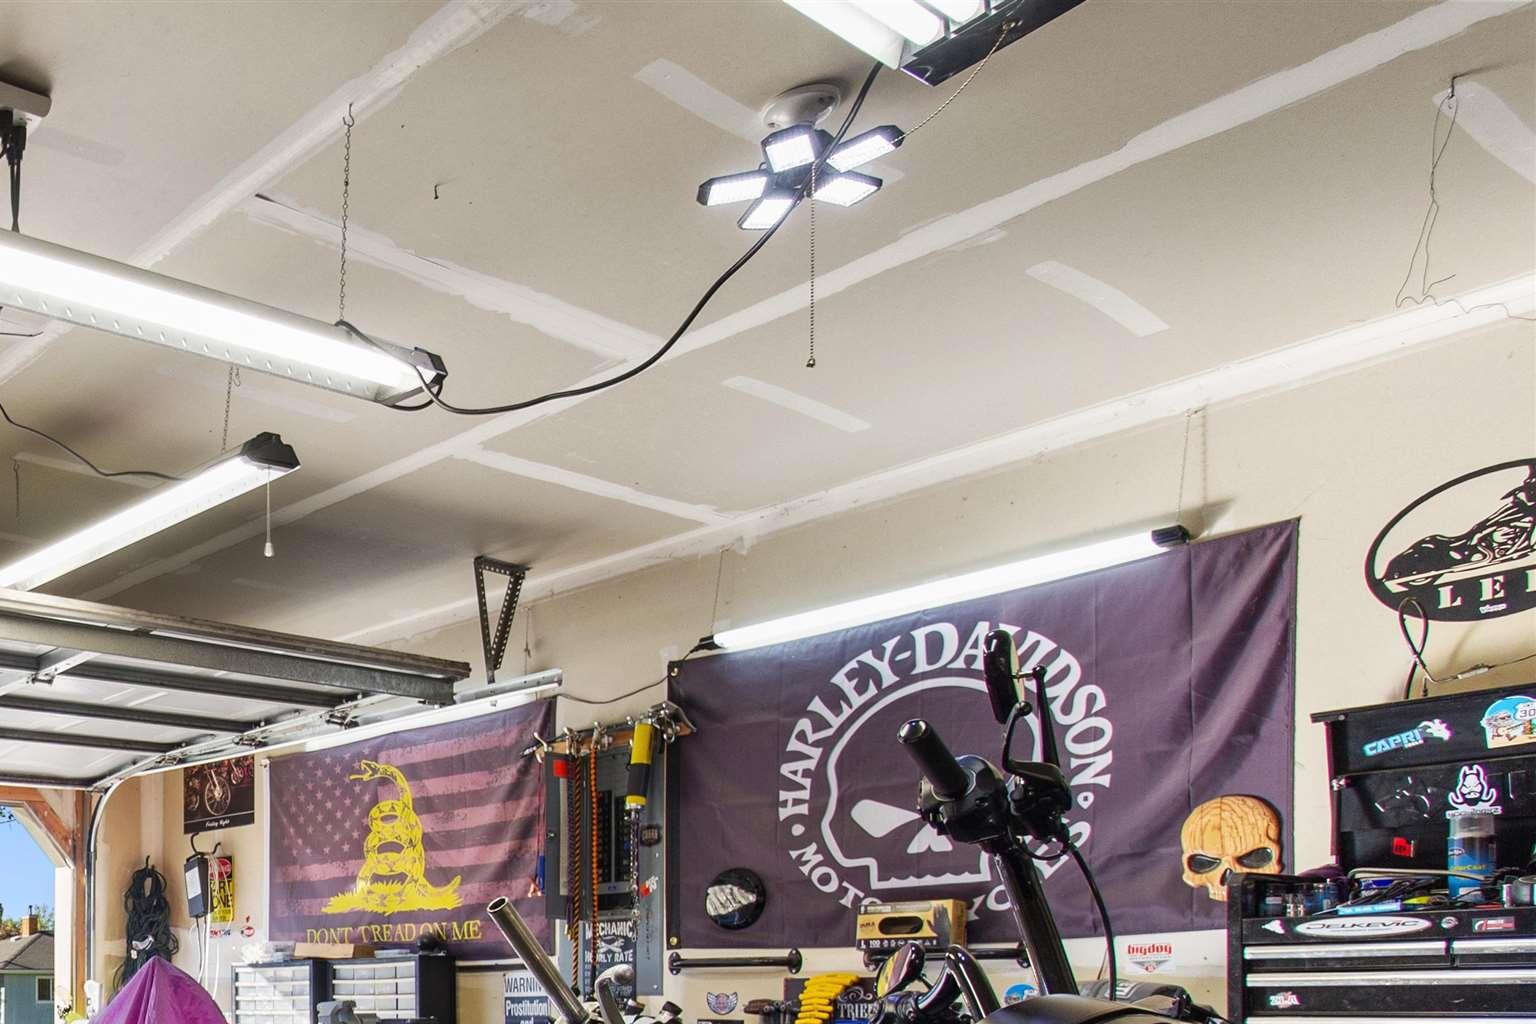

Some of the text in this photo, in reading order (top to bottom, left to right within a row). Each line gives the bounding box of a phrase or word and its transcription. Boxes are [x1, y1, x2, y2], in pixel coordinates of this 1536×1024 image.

[1363, 730, 1424, 757] CAPRI
[358, 923, 416, 943] TREAD
[451, 919, 482, 941] ME
[614, 949, 634, 963] RATE
[506, 999, 548, 1017] Prostitution
